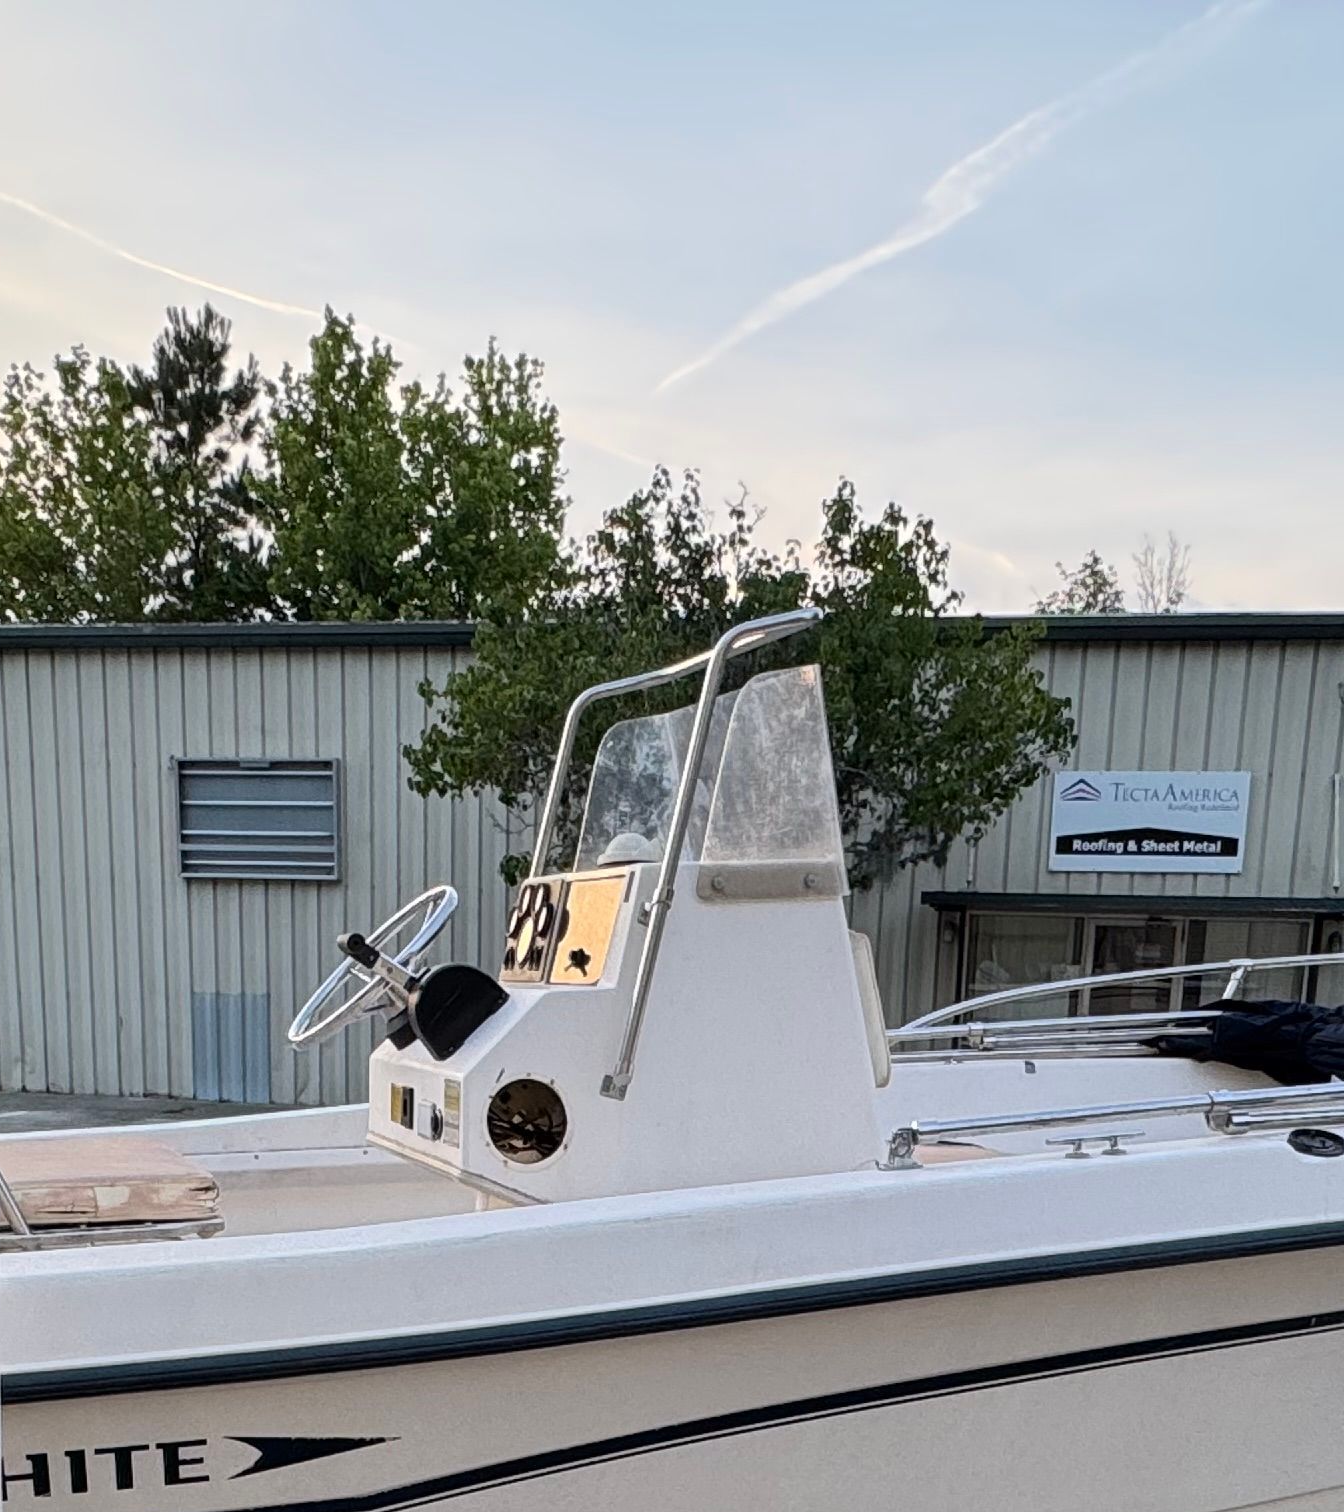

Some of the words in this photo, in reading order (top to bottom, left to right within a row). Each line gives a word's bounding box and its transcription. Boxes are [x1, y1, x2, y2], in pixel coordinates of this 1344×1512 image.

[1072, 839, 1124, 853] Roofing
[1127, 840, 1138, 852] &
[1141, 840, 1180, 852] Sheet
[1183, 840, 1222, 854] Metal
